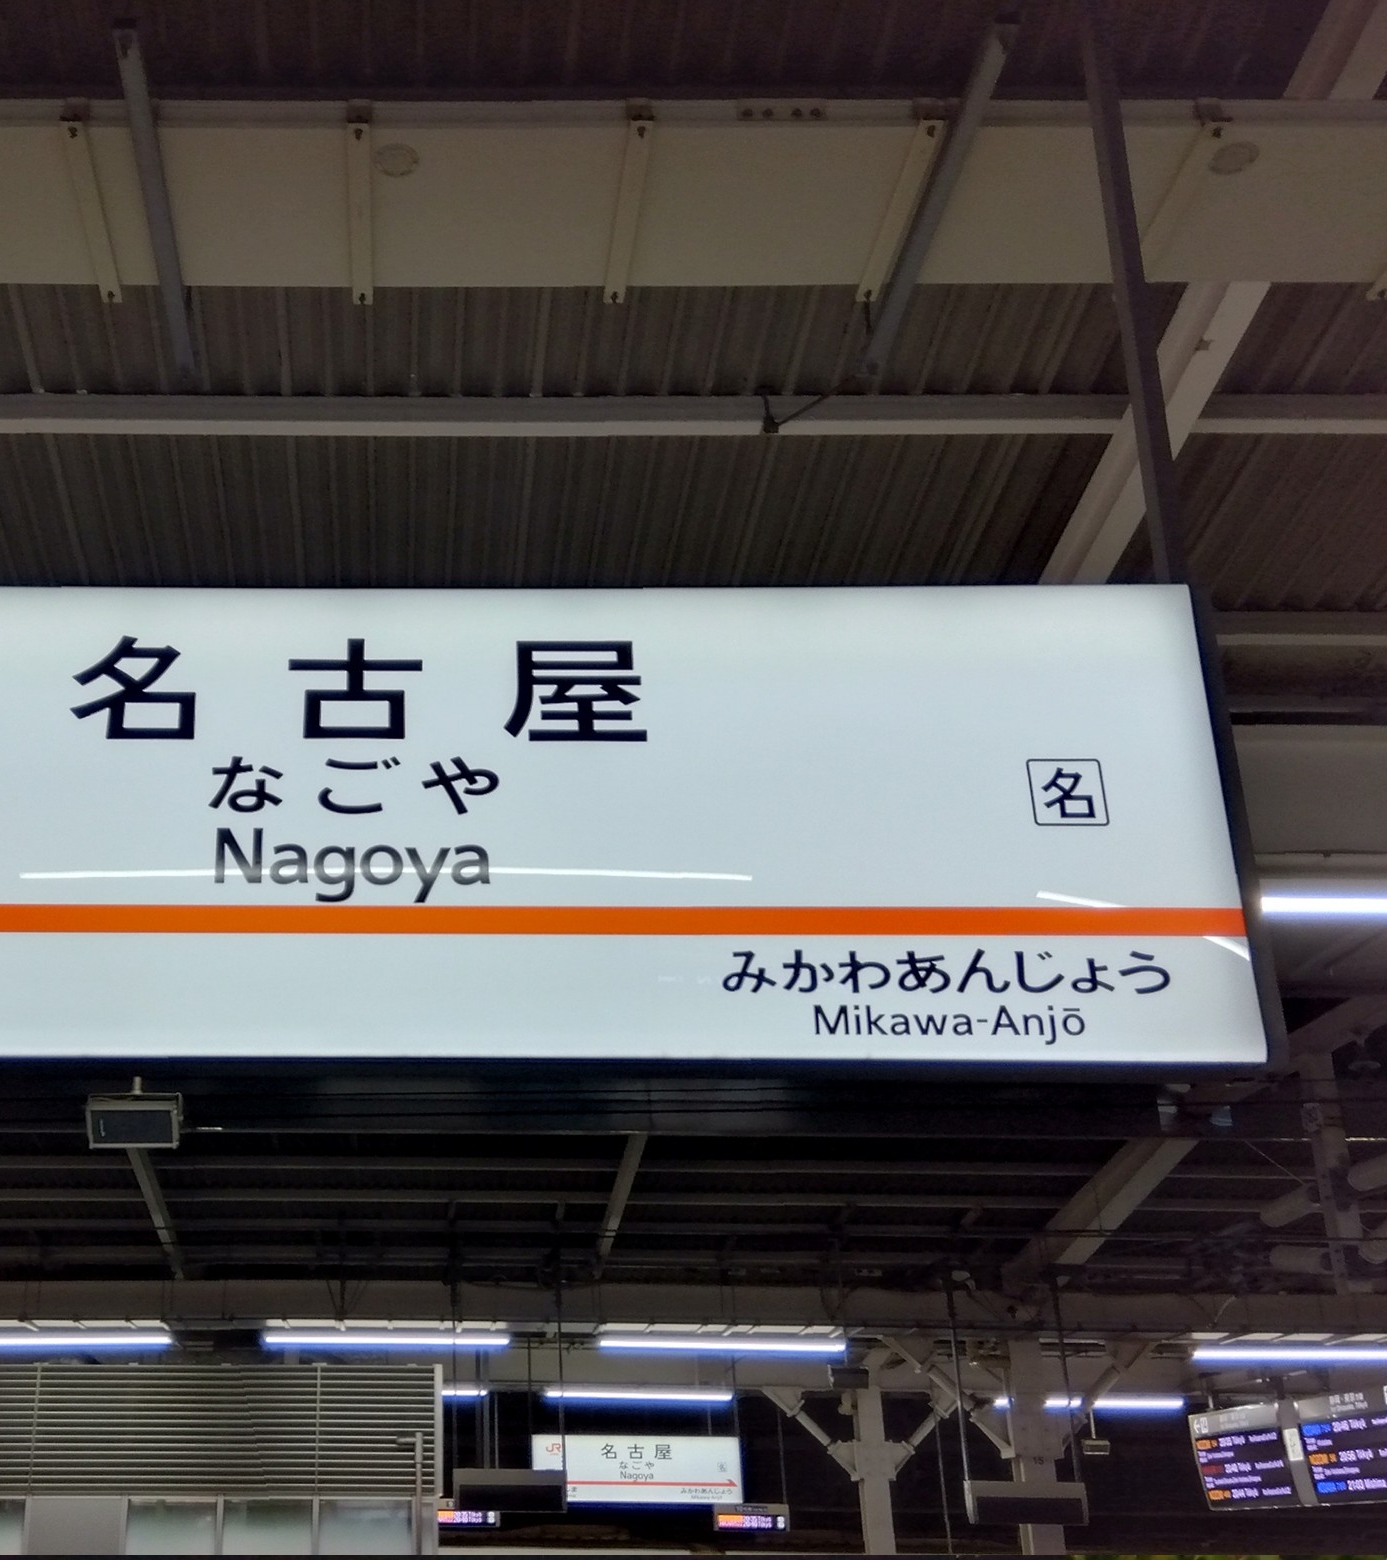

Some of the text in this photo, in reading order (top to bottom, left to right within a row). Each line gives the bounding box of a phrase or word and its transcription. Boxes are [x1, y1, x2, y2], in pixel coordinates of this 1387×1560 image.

[69, 635, 648, 743] 名古屋
[208, 755, 500, 816] なごや
[1040, 767, 1097, 820] 名
[214, 827, 491, 904] Nagoya
[721, 948, 1171, 995] みかわあんじょう
[813, 1004, 1086, 1046] Mikawa-Anjō
[545, 1442, 562, 1453] JR
[600, 1443, 673, 1460] 名古屋
[620, 1471, 655, 1482] Nagoya
